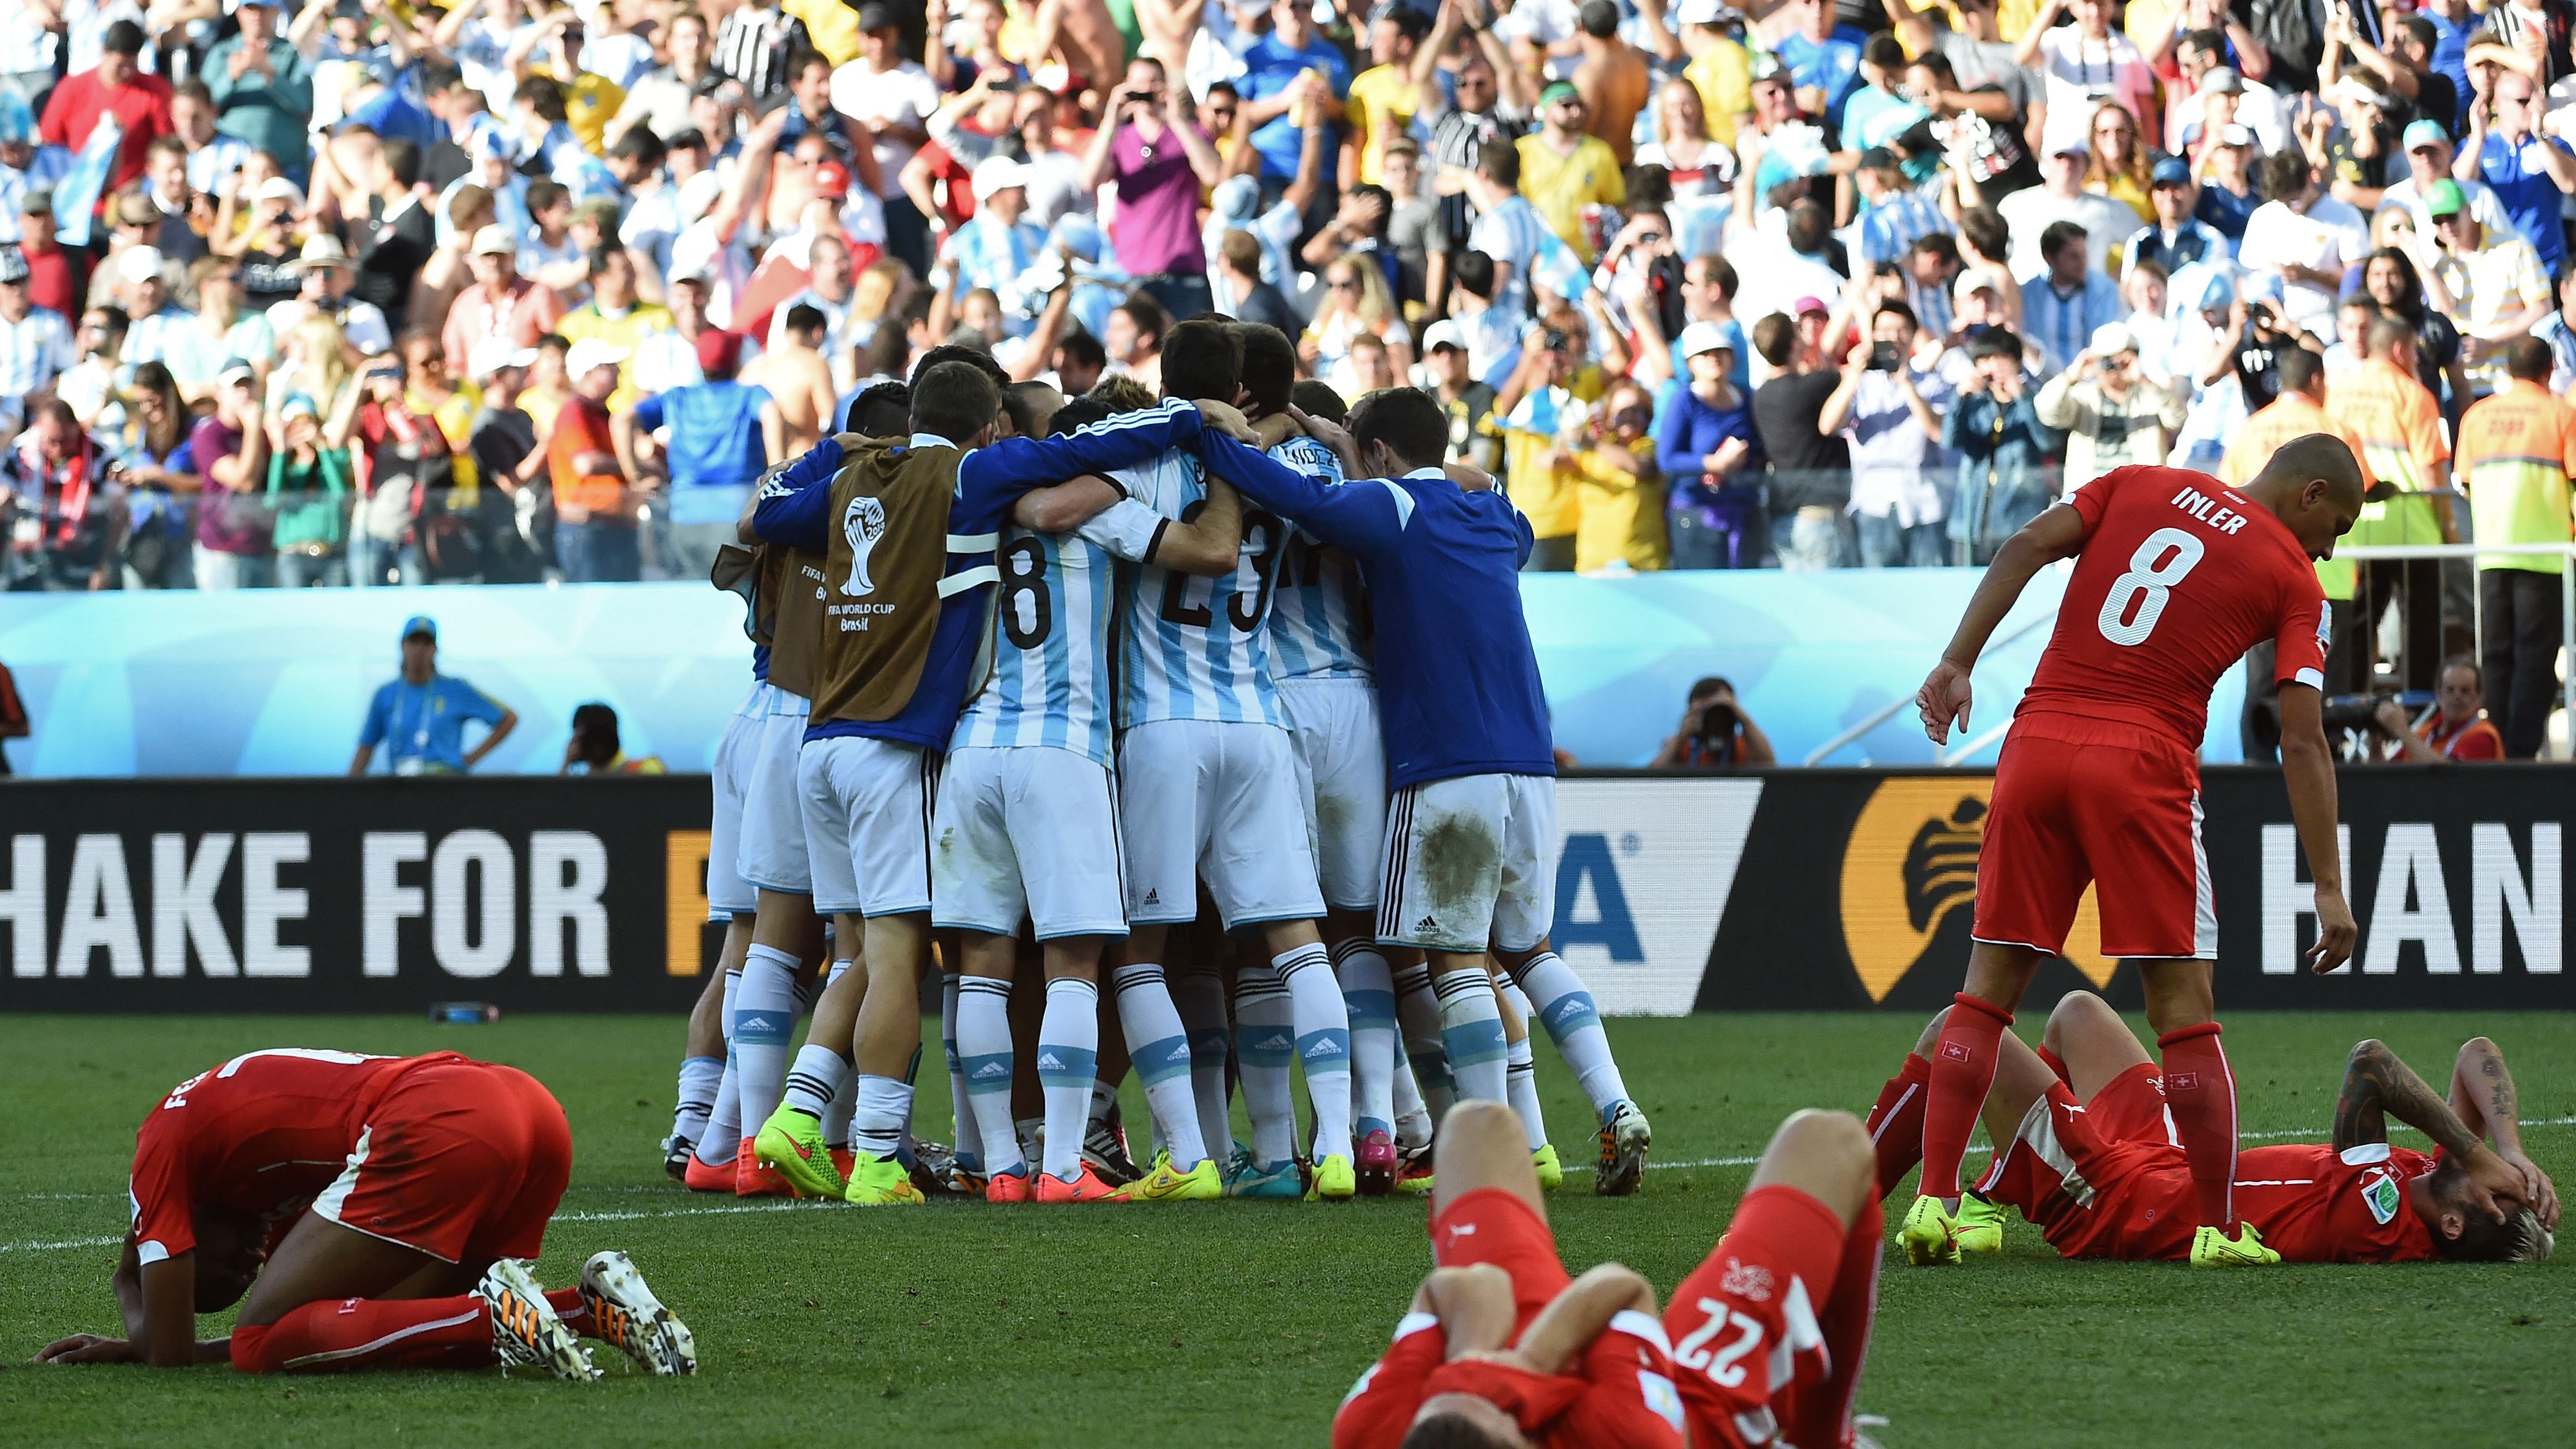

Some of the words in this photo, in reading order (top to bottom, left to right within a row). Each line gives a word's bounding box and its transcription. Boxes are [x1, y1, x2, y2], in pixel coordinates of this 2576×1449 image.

[1286, 448, 1335, 467] NDEZ
[2171, 486, 2248, 535] INLER
[801, 565, 821, 581] FIFA
[1001, 536, 1051, 649] 8
[2098, 527, 2205, 646] 8
[828, 605, 841, 615] FIFA
[841, 604, 871, 614] WORLD
[873, 604, 896, 614] CUP
[841, 617, 868, 632] Brasil
[362, 828, 611, 978] FOR
[2261, 822, 2562, 975] HAN
[1305, 1046, 1342, 1058] adidas
[972, 1070, 1010, 1079] adidas
[1917, 1198, 1928, 1224] TIEMPO
[1672, 1298, 1765, 1388] 22
